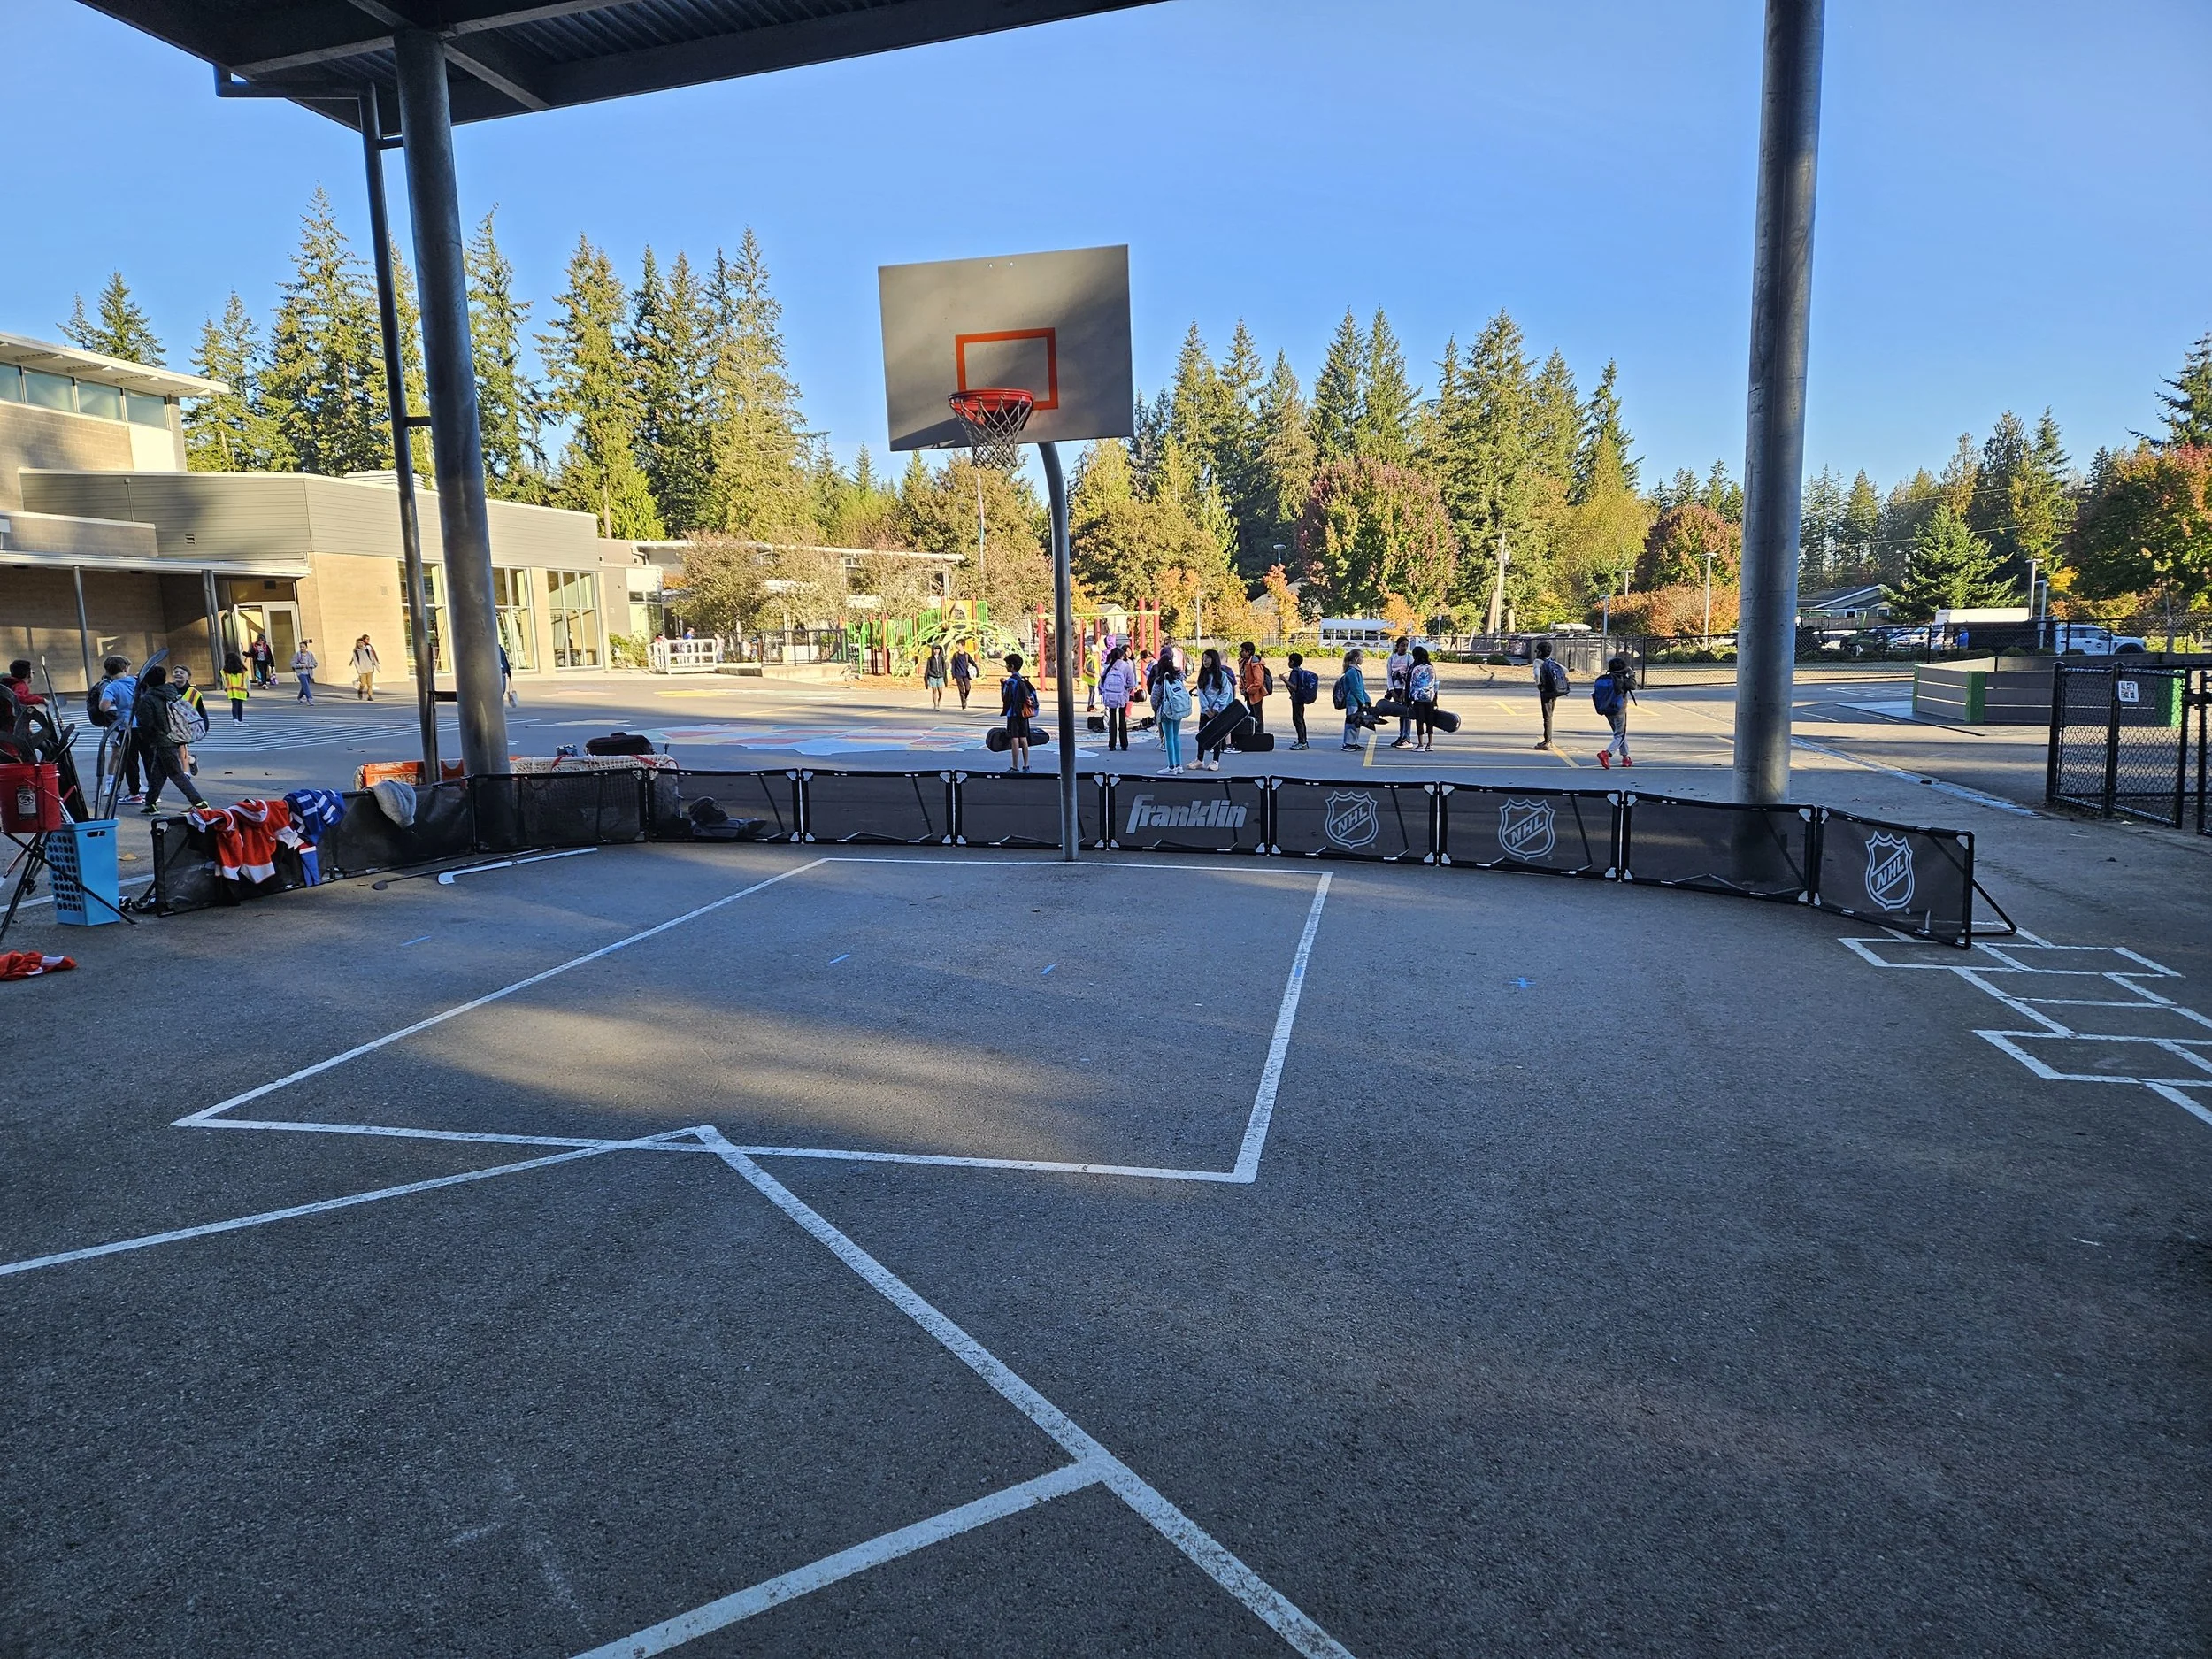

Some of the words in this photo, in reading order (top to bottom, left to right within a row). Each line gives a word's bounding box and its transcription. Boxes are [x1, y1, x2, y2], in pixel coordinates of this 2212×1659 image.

[1125, 794, 1248, 834] Franklin
[1337, 806, 1368, 834] NHL
[1510, 815, 1544, 845] NHL
[1876, 856, 1905, 890] NHL
